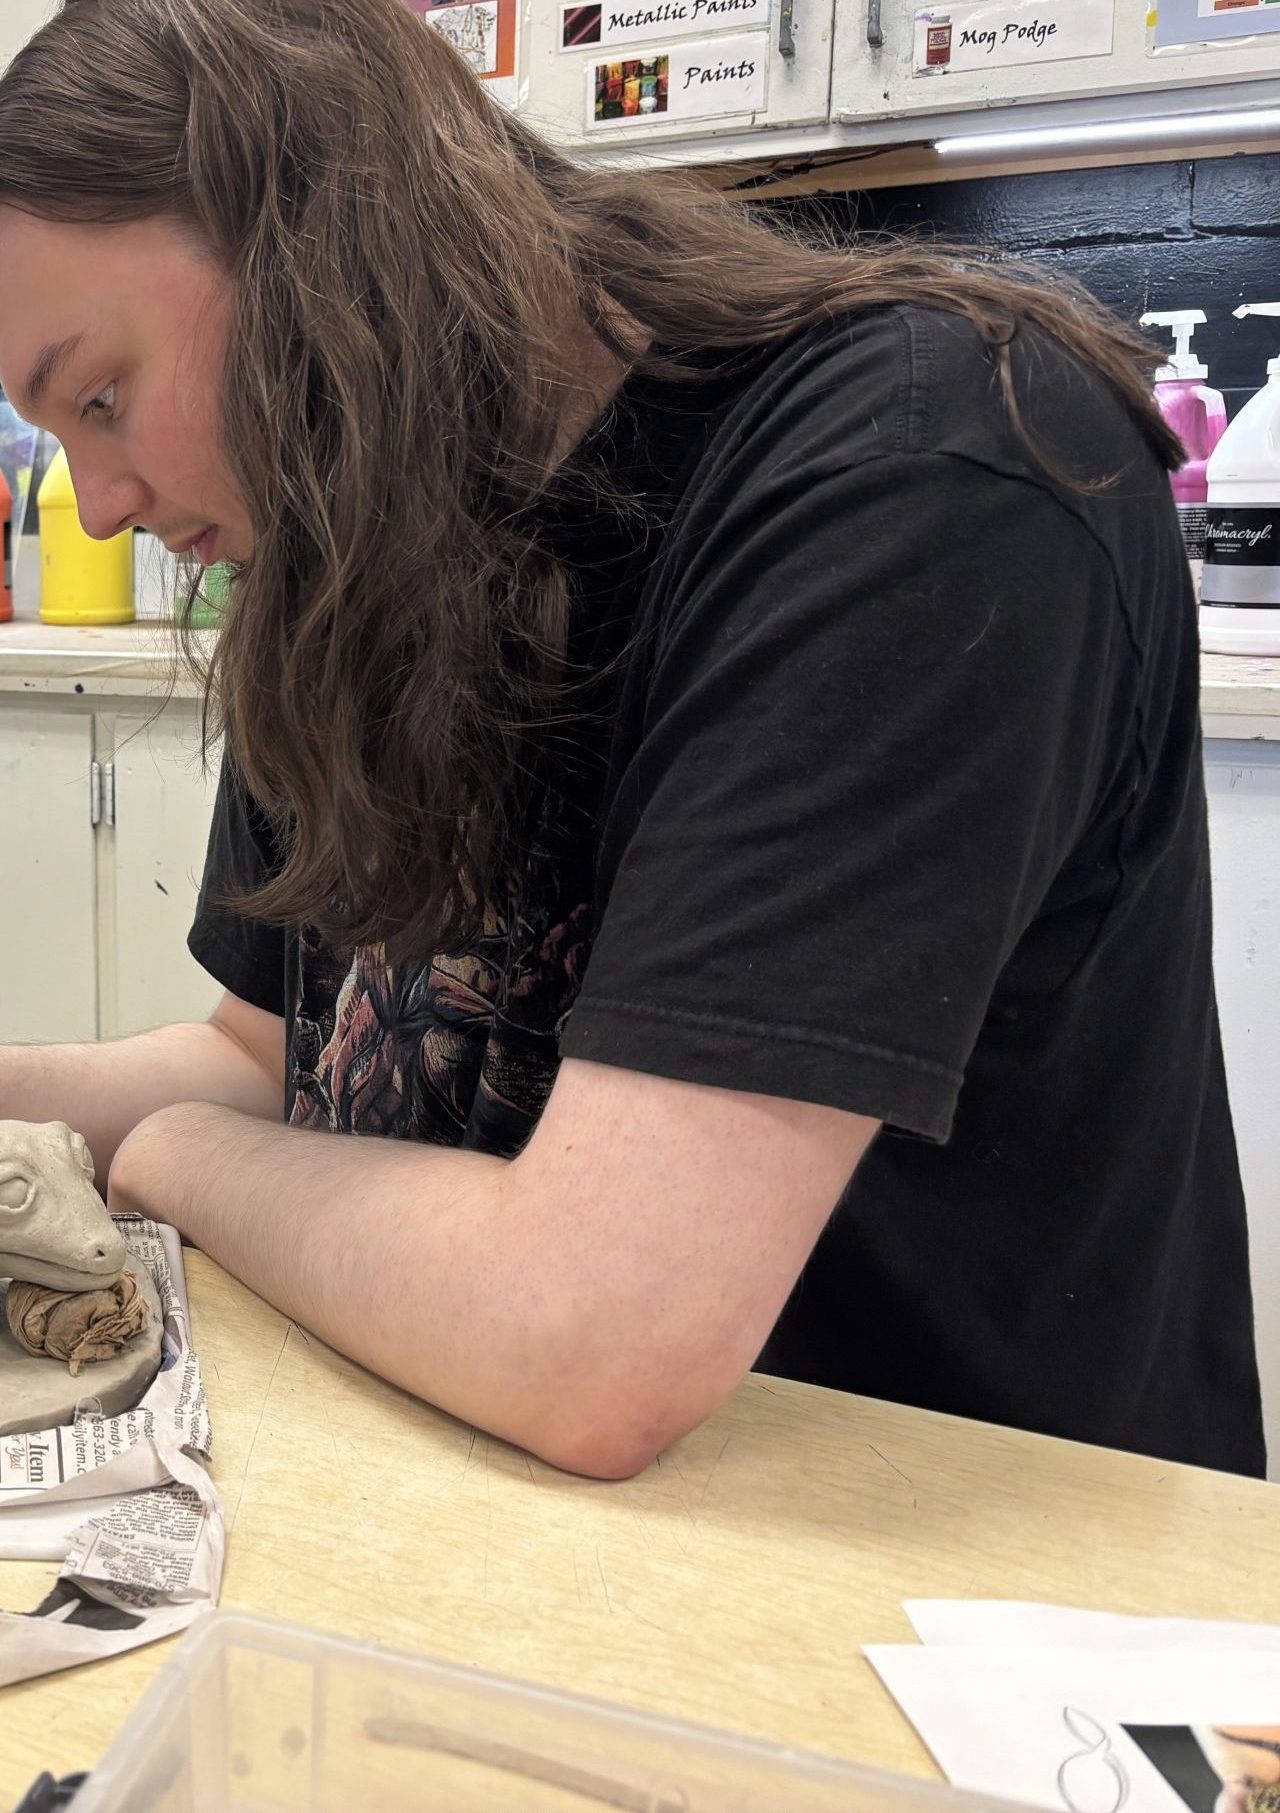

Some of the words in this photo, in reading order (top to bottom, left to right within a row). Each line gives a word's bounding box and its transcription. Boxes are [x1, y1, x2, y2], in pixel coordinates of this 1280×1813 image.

[607, 4, 687, 31] Metallic
[691, 0, 756, 20] Paints
[959, 30, 997, 54] Mog
[1001, 19, 1057, 47] Podge
[683, 60, 755, 89] Paints
[29, 1443, 50, 1483] Item
